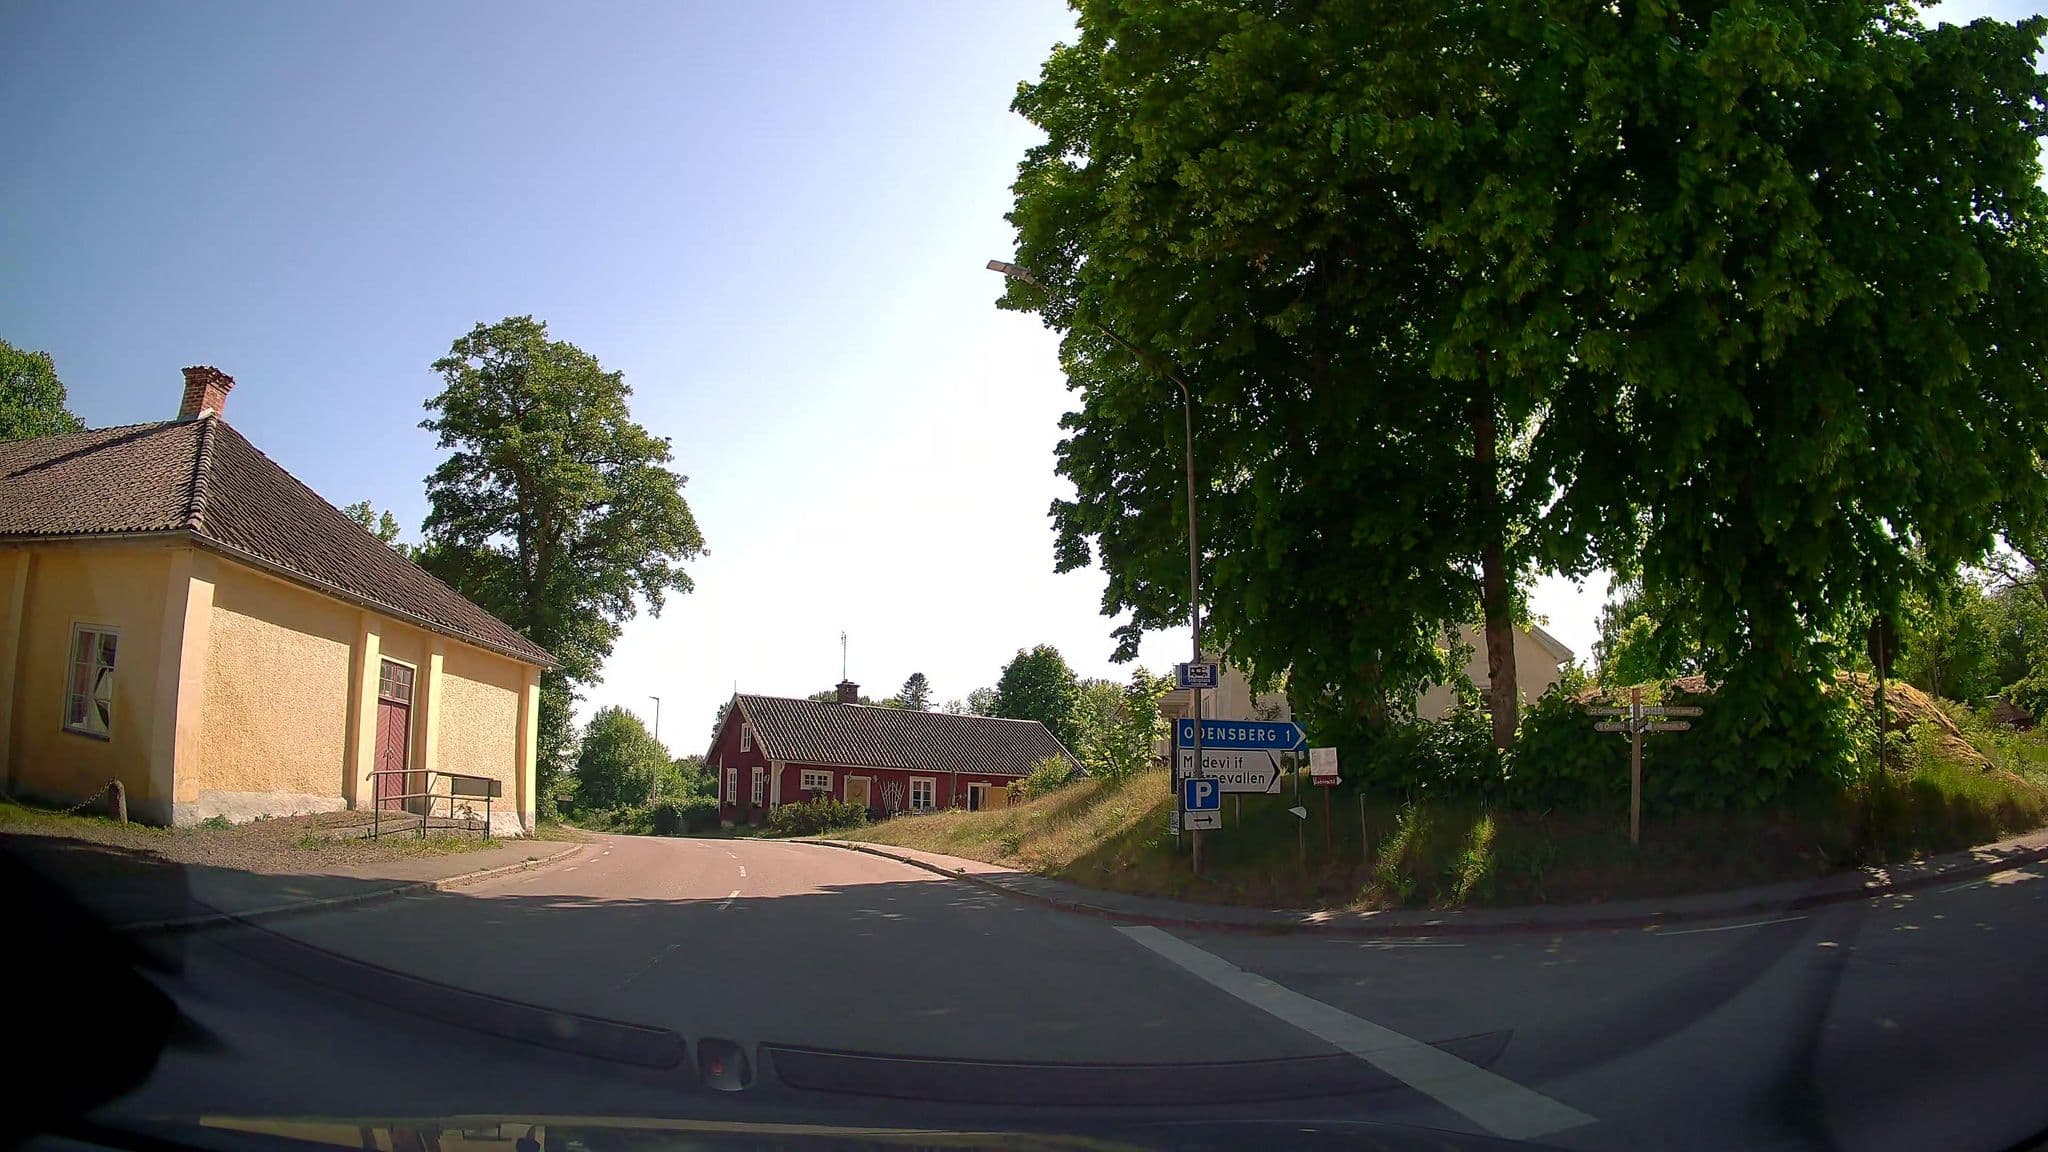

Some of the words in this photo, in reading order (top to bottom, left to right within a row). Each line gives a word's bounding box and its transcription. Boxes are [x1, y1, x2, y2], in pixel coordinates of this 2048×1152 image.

[1286, 729, 1290, 742] 1
[1184, 756, 1230, 769] Mdevi
[1235, 756, 1243, 769] if
[1196, 782, 1212, 807] P
